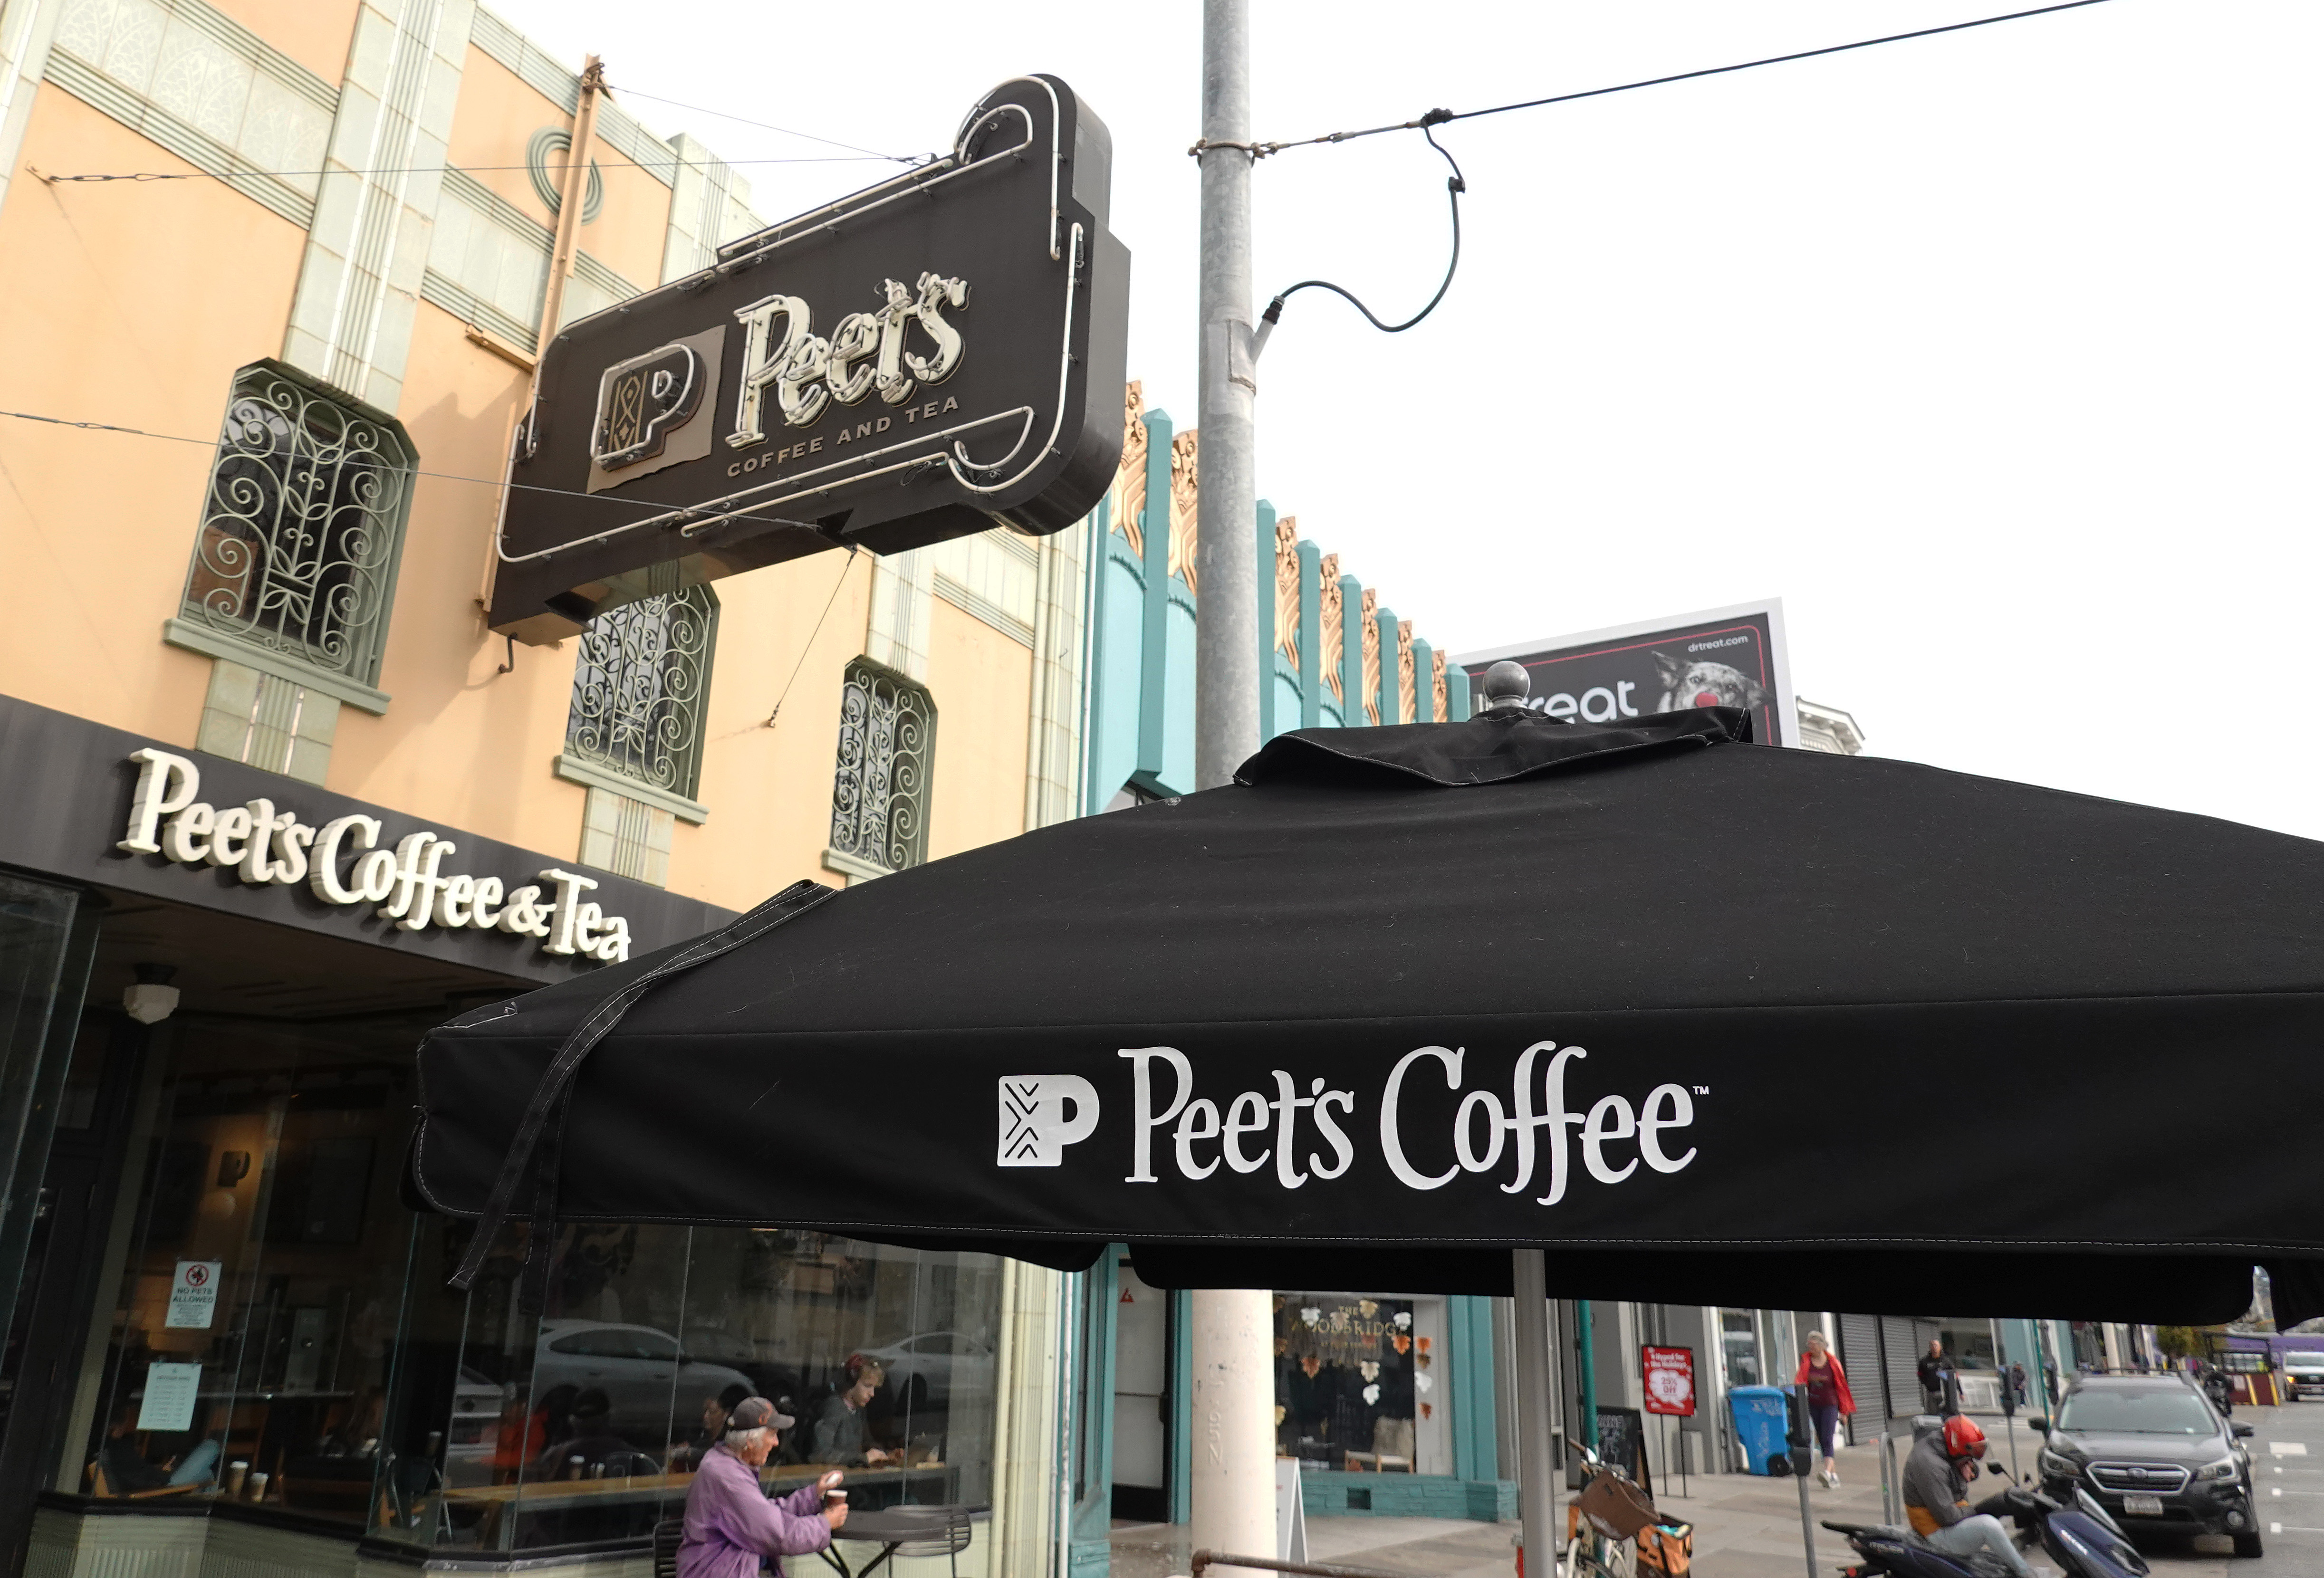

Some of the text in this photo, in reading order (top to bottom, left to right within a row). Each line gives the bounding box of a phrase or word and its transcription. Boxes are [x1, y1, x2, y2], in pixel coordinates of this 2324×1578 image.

[726, 271, 971, 450] Peet's
[727, 395, 959, 478] COFFEE AND TEA
[1522, 680, 1638, 724] reat
[1688, 635, 1748, 652] drtreat.com
[116, 747, 632, 963] Peet's Coffee & Tea
[1117, 1046, 1354, 1189] Peet's
[1380, 1040, 1697, 1206] Coffee
